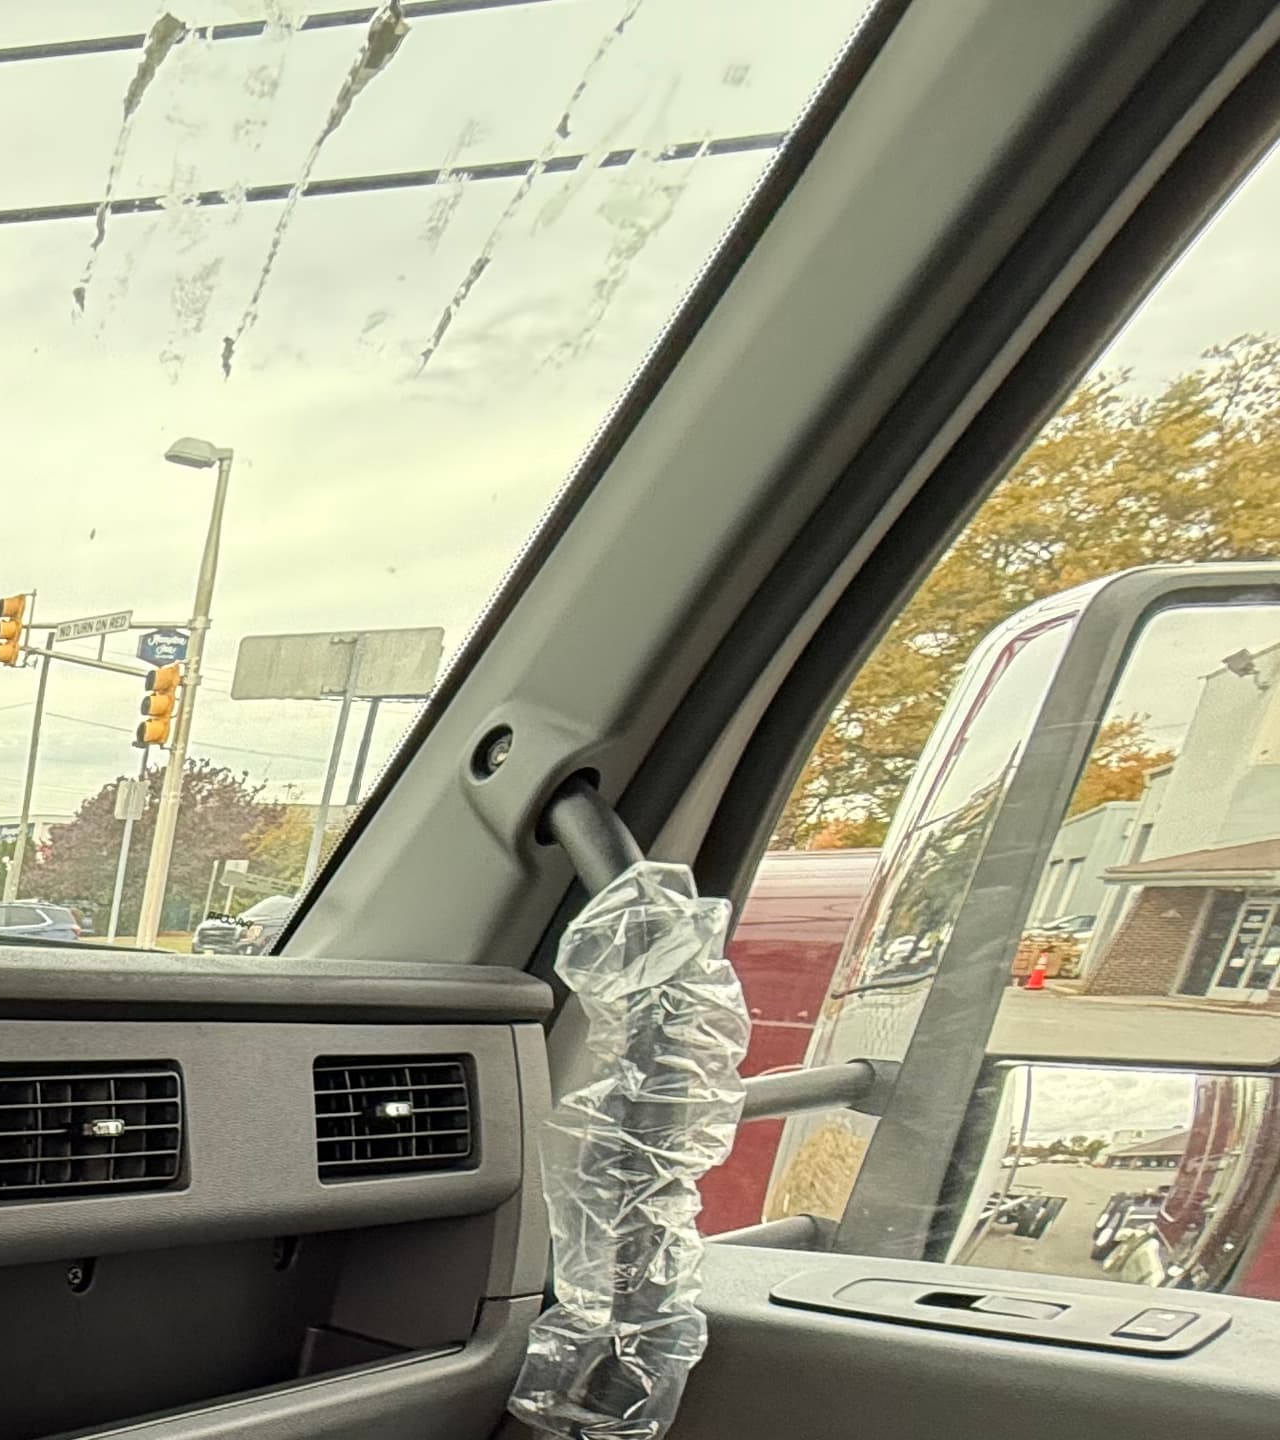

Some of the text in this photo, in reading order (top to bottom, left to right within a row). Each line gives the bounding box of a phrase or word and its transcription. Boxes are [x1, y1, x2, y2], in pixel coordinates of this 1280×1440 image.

[59, 615, 127, 637] NO TURN ON RED
